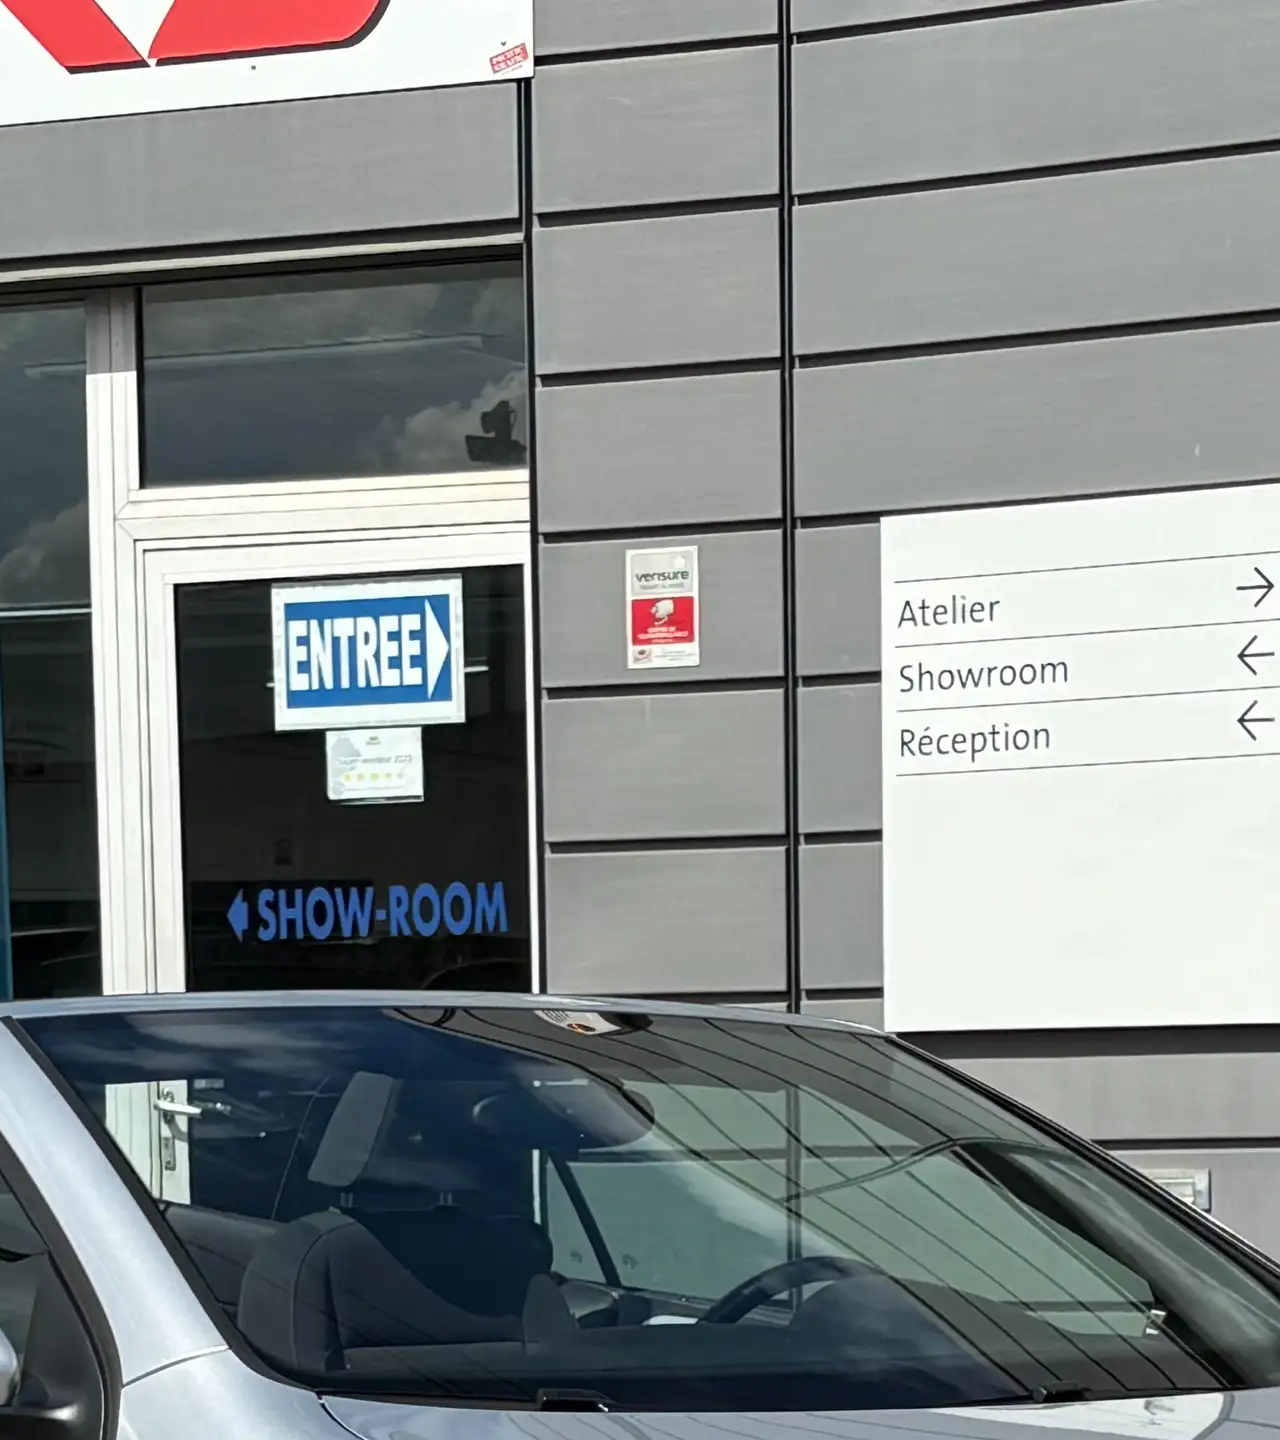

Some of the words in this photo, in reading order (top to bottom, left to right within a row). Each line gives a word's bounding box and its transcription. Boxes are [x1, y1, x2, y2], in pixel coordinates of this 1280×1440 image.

[897, 596, 1000, 628] Atelier
[287, 613, 423, 691] ENTREE
[899, 657, 1068, 693] Showroom
[900, 722, 1051, 763] Réception
[258, 881, 508, 941] SHOW-ROOM
